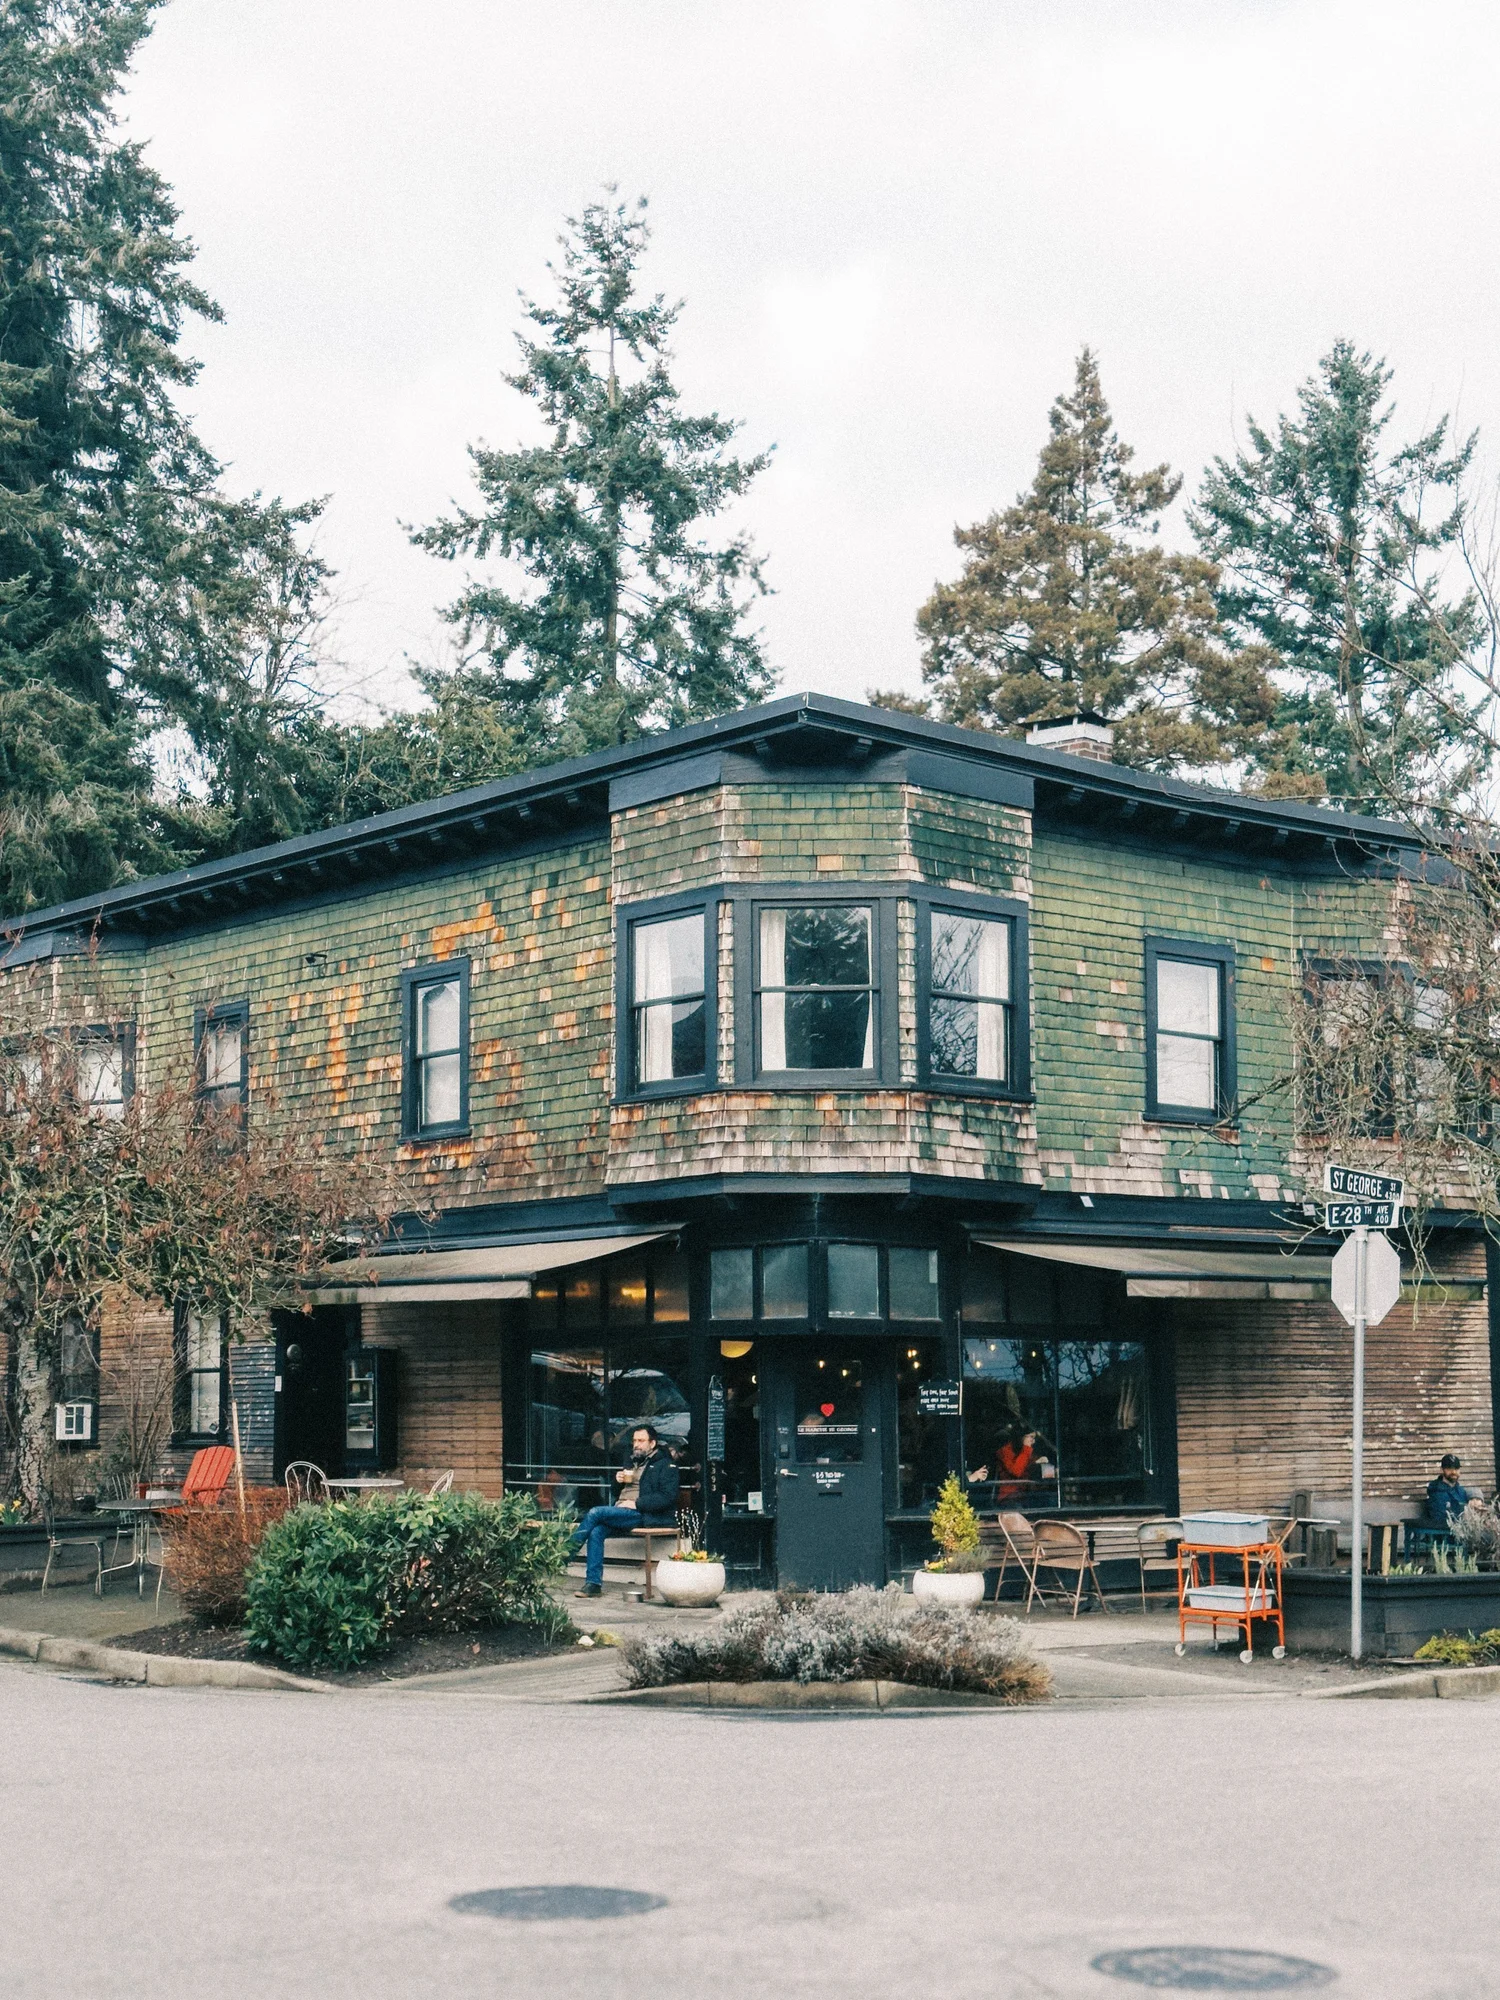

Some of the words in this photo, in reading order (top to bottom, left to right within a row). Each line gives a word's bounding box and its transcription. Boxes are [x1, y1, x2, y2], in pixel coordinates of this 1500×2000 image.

[1333, 1171, 1345, 1190] ST
[1347, 1174, 1382, 1197] GEORGE
[1390, 1183, 1396, 1191] ST
[1332, 1207, 1340, 1224] E
[1377, 1206, 1389, 1214] AVE
[1375, 1215, 1389, 1224] 400
